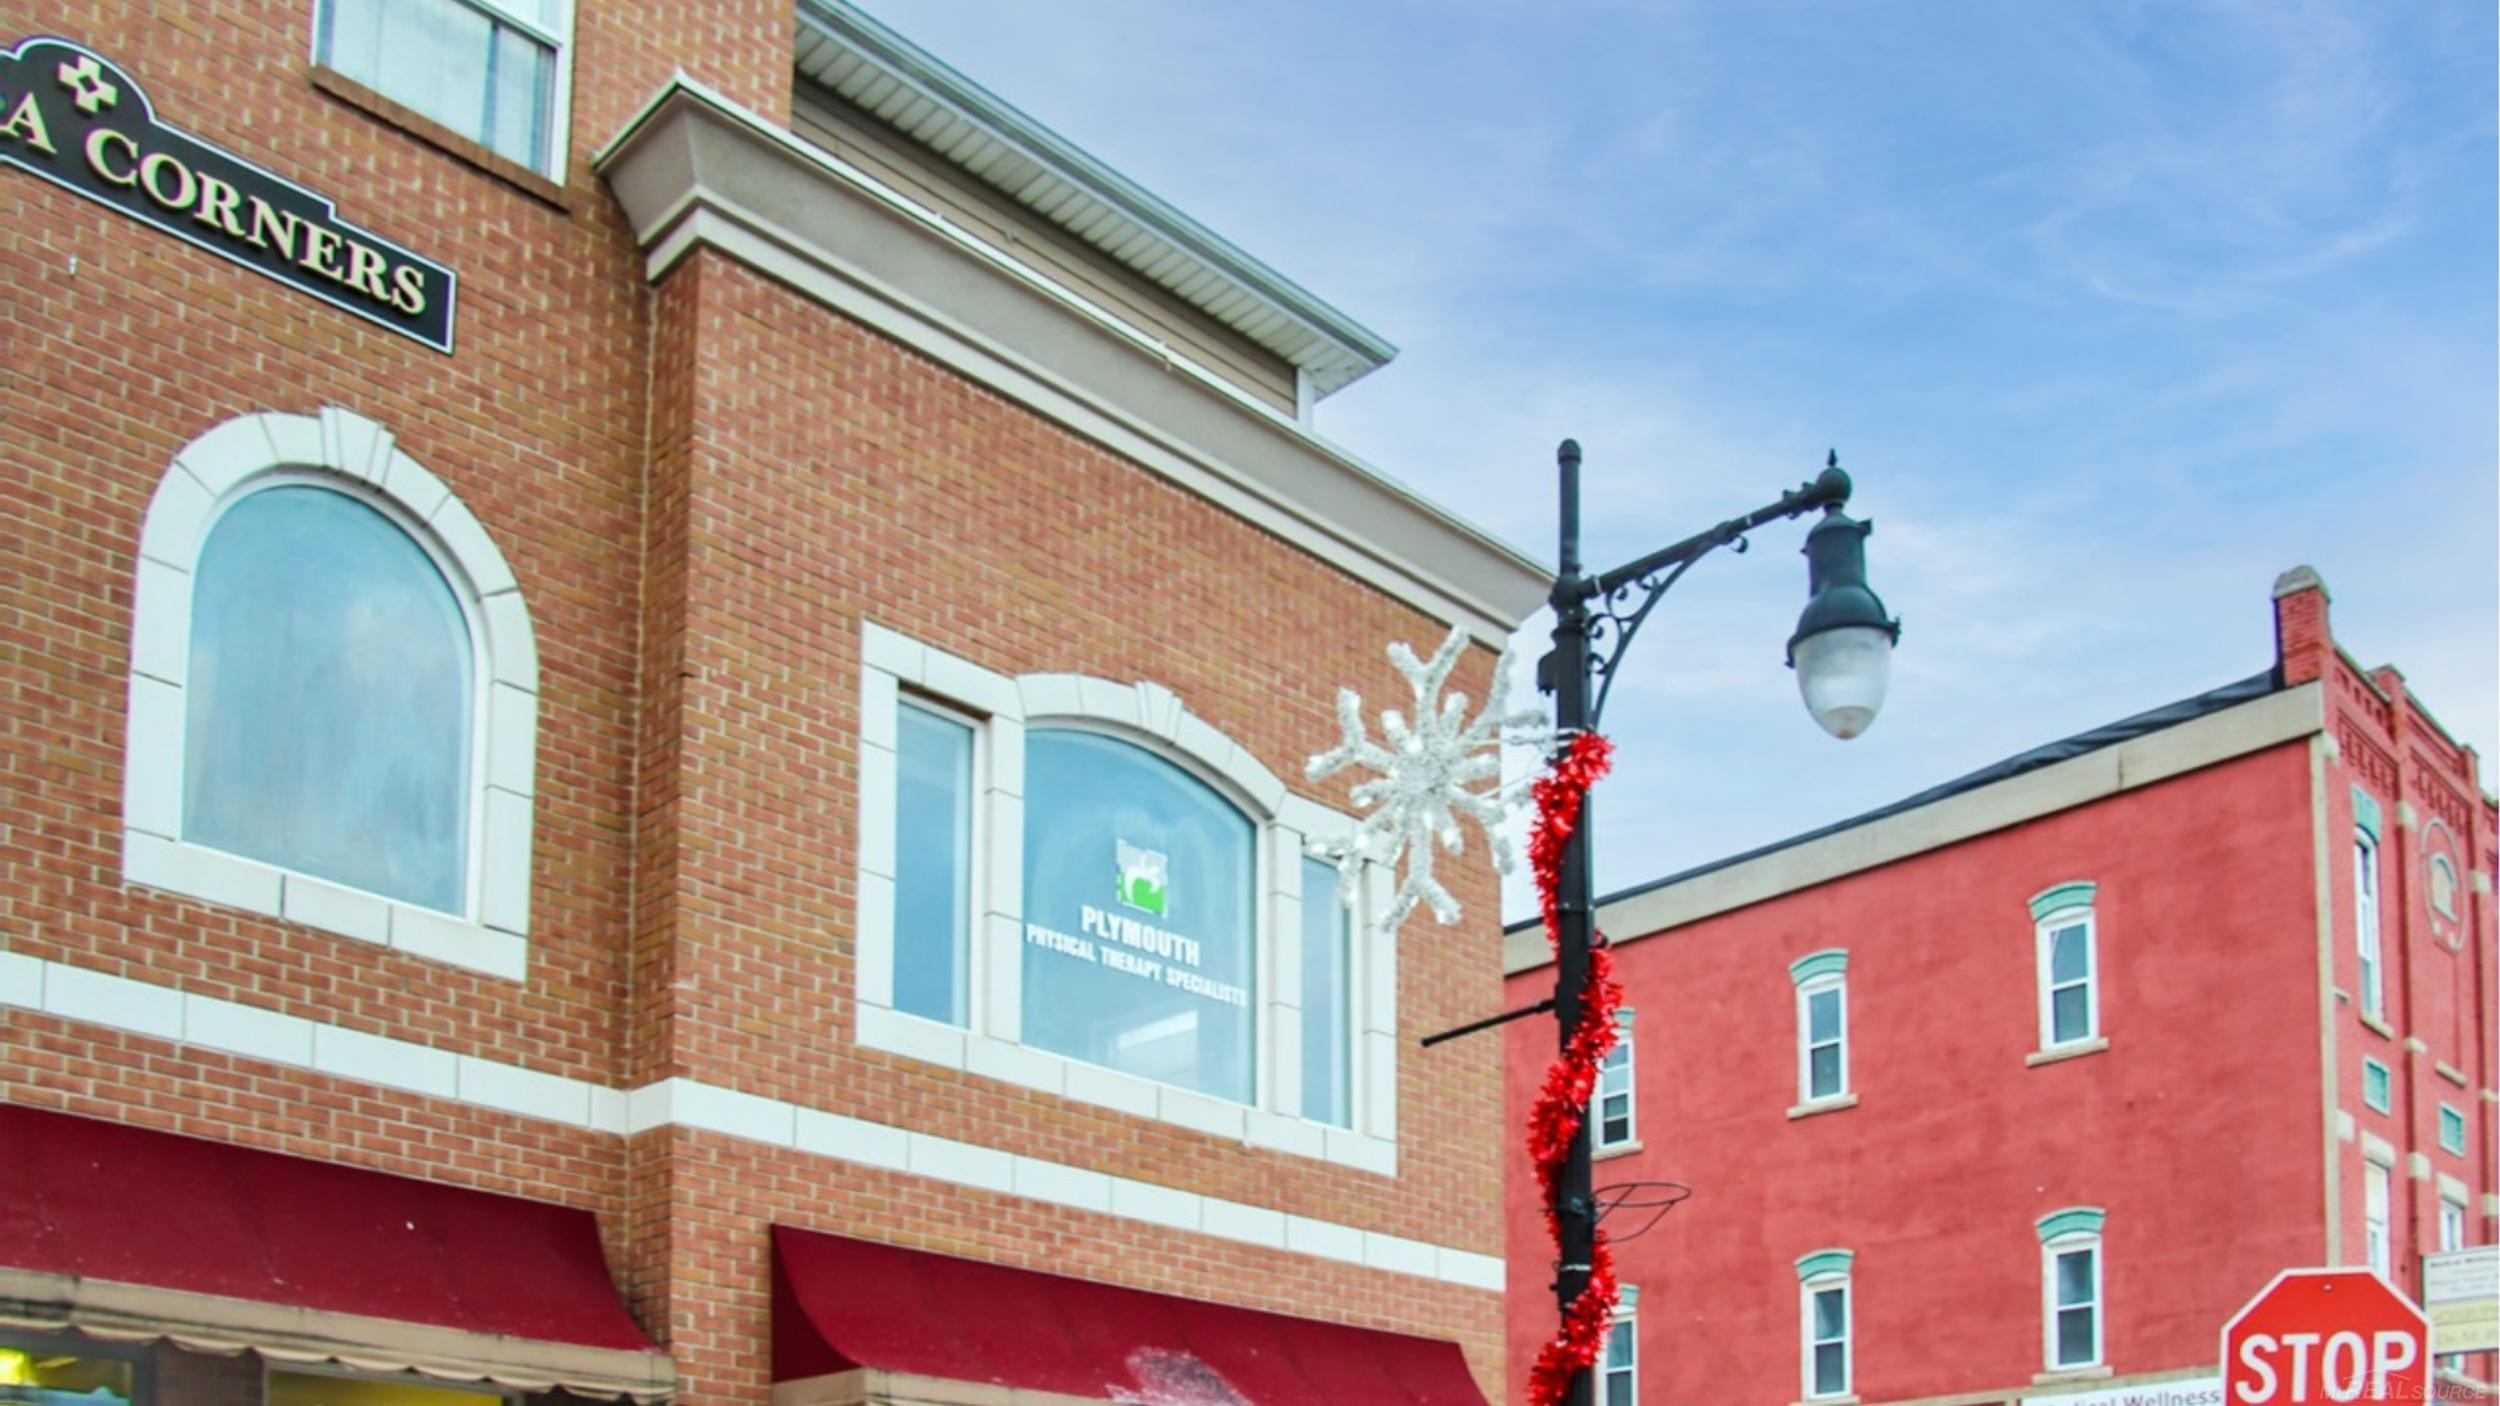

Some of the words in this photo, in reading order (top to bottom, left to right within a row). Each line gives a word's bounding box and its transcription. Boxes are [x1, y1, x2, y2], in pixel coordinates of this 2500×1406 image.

[0, 92, 58, 154] A
[86, 129, 426, 314] CORNERS
[1026, 923, 1096, 962] PHYSICAL
[1100, 946, 1162, 981] THERAPY
[1165, 967, 1247, 1008] SPECIALISTS
[1081, 904, 1200, 967] PLYMOUTH
[2235, 1330, 2417, 1404] STOP
